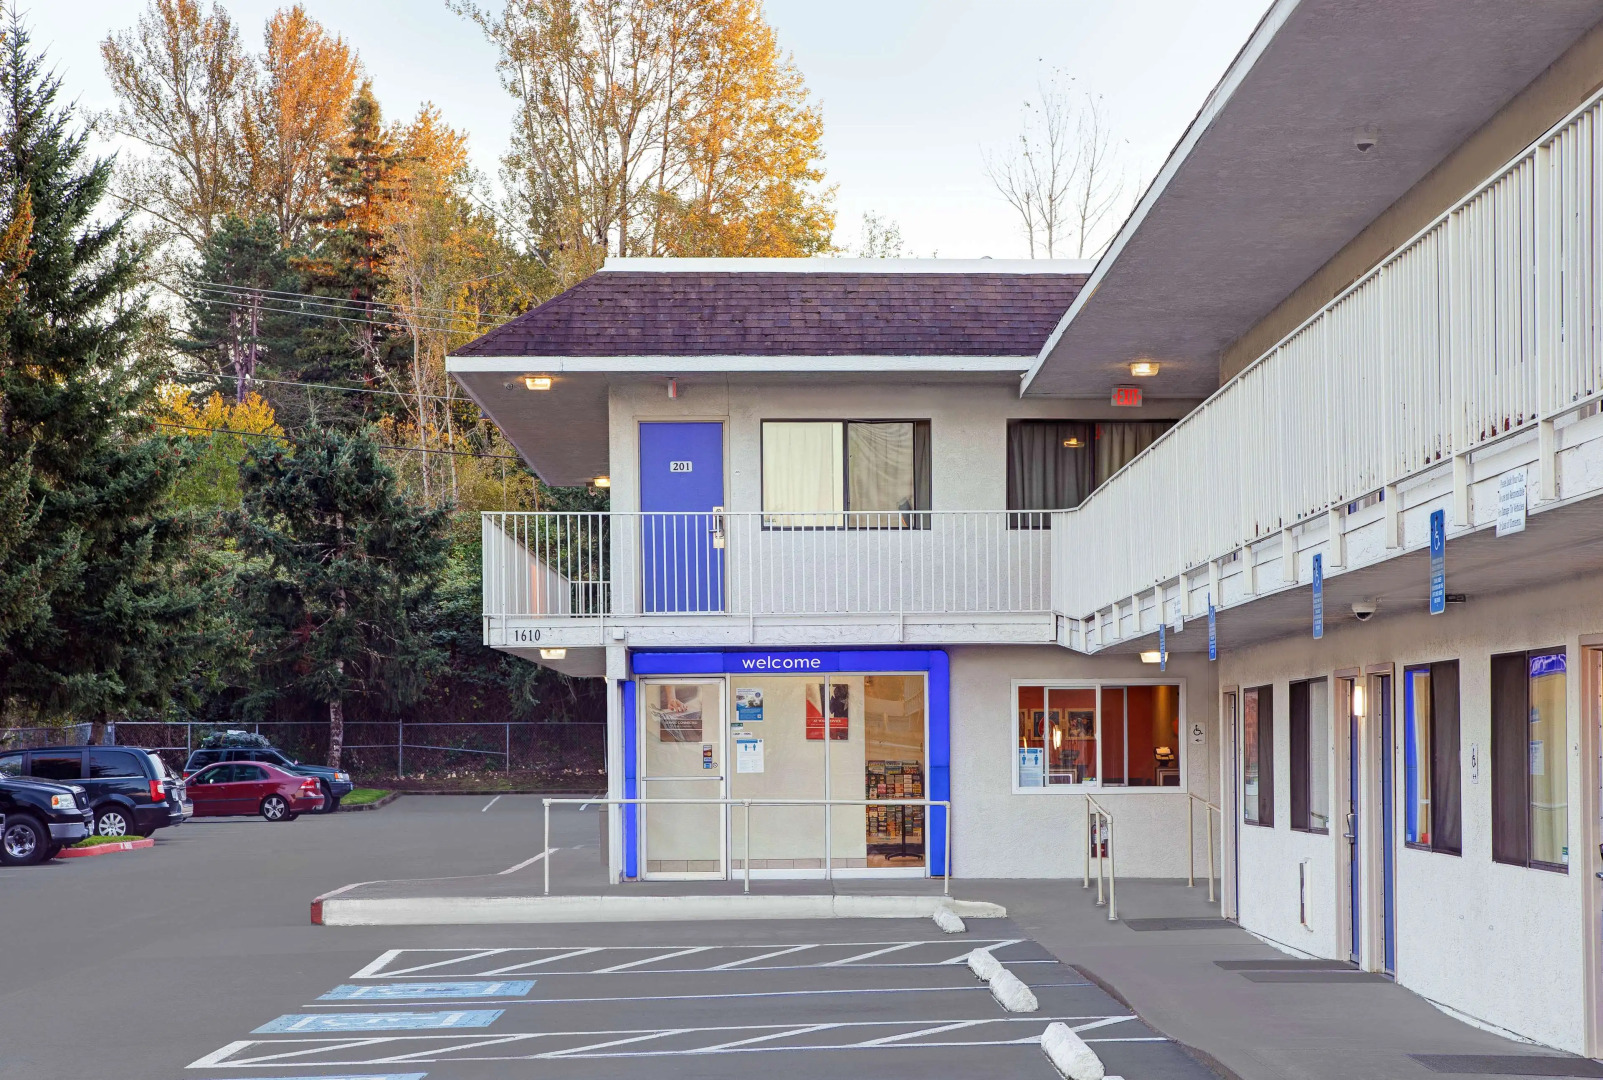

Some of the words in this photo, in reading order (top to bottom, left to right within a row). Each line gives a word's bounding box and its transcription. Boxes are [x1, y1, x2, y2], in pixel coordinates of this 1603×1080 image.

[1117, 388, 1138, 405] EXIT
[673, 462, 690, 470] 201
[515, 629, 540, 641] 1610
[742, 656, 820, 668] welcome
